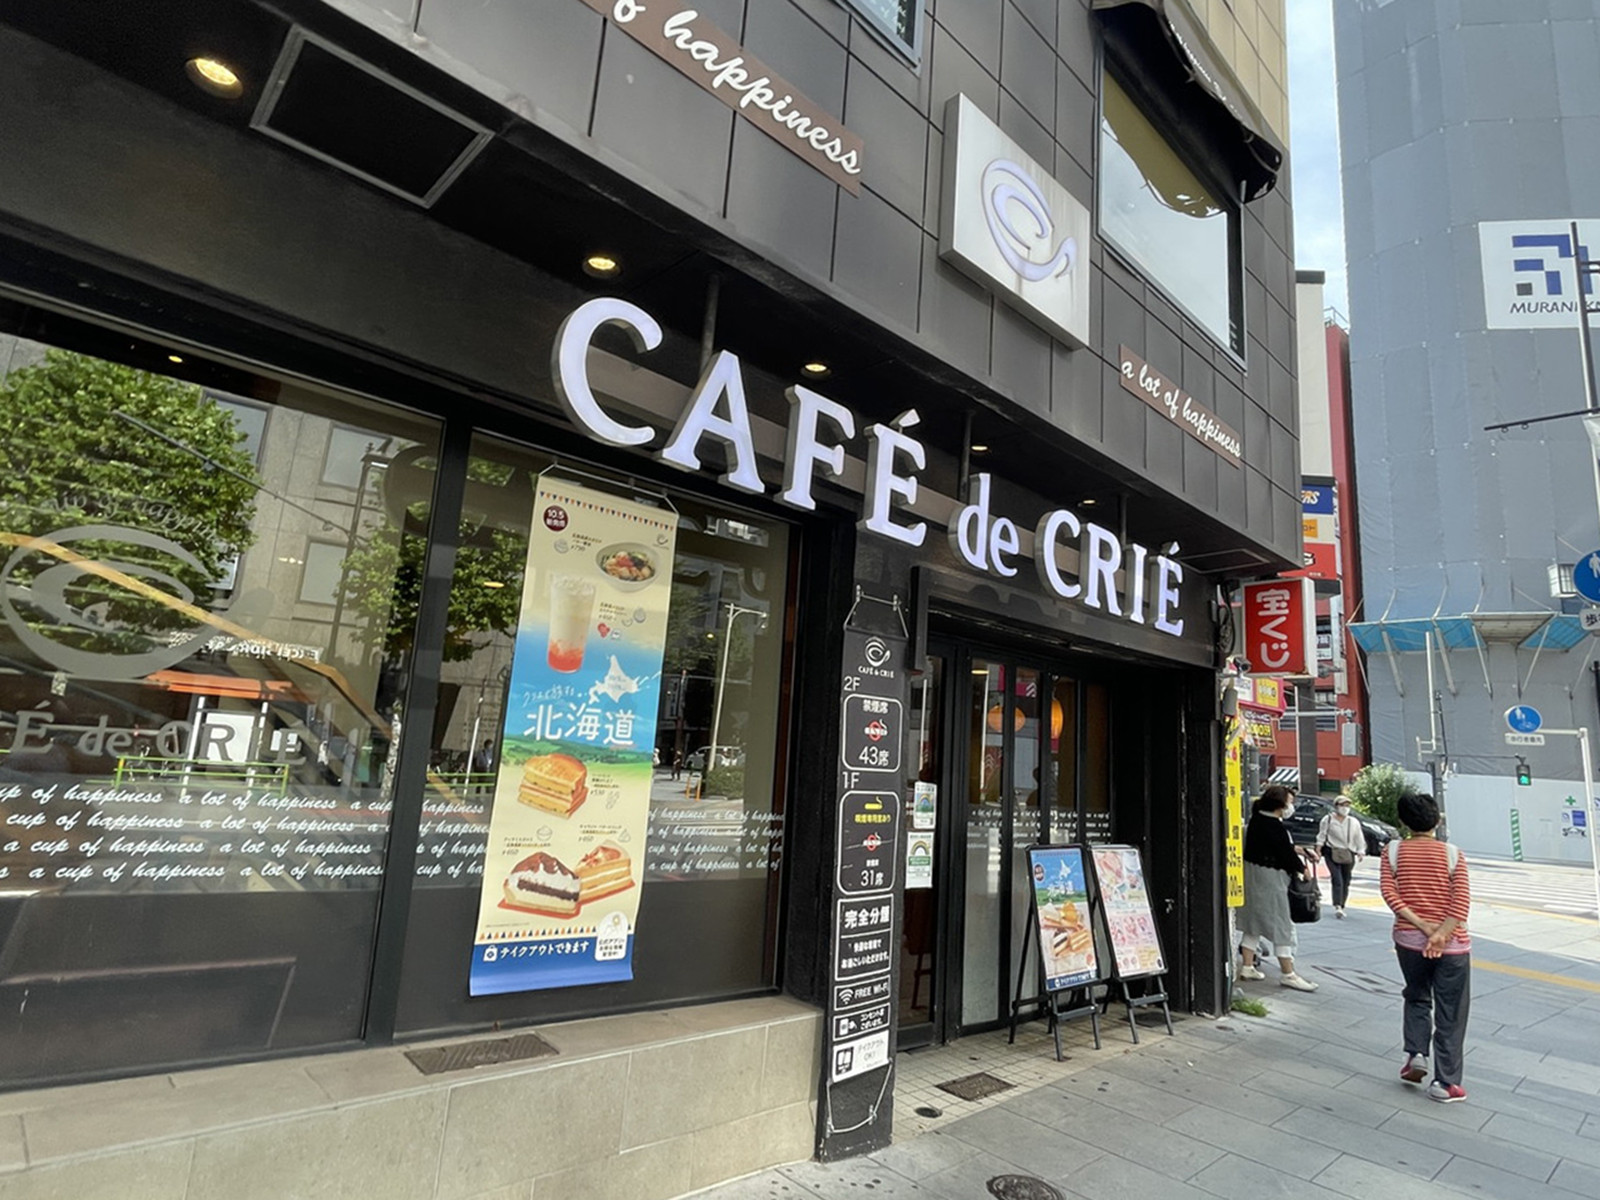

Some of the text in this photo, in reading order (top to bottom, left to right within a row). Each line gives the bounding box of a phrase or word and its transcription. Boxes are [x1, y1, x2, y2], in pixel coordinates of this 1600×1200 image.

[663, 10, 861, 174] happiness
[1121, 361, 1241, 458] a lot of happiness
[553, 297, 1184, 637] CAFÉ de CRIÉ
[1256, 588, 1291, 668] 宝くじ
[844, 675, 861, 692] 2F
[523, 703, 636, 746] 北海道
[842, 771, 860, 789] 1F
[32, 784, 58, 805] of
[63, 784, 163, 806] happiness
[179, 795, 193, 805] a
[201, 791, 227, 806] lot
[232, 792, 254, 811] of
[257, 791, 338, 811] happiness
[350, 800, 362, 811] a
[6, 811, 47, 830] cup
[55, 811, 83, 831] of
[87, 810, 184, 832] happiness
[200, 820, 214, 829] a
[221, 816, 246, 830] lot
[252, 816, 274, 834] of
[277, 816, 356, 835] happiness
[3, 836, 372, 858] a cup of happiness a lot of happiness
[29, 865, 45, 879] a
[55, 864, 94, 882] cup
[102, 862, 128, 883] of
[132, 862, 226, 882] happiness
[240, 865, 253, 876] a
[261, 861, 286, 876] lot
[290, 862, 311, 880] of
[416, 863, 442, 878] cup
[500, 940, 590, 960] テイクアウトできます
[854, 985, 872, 999] FREE
